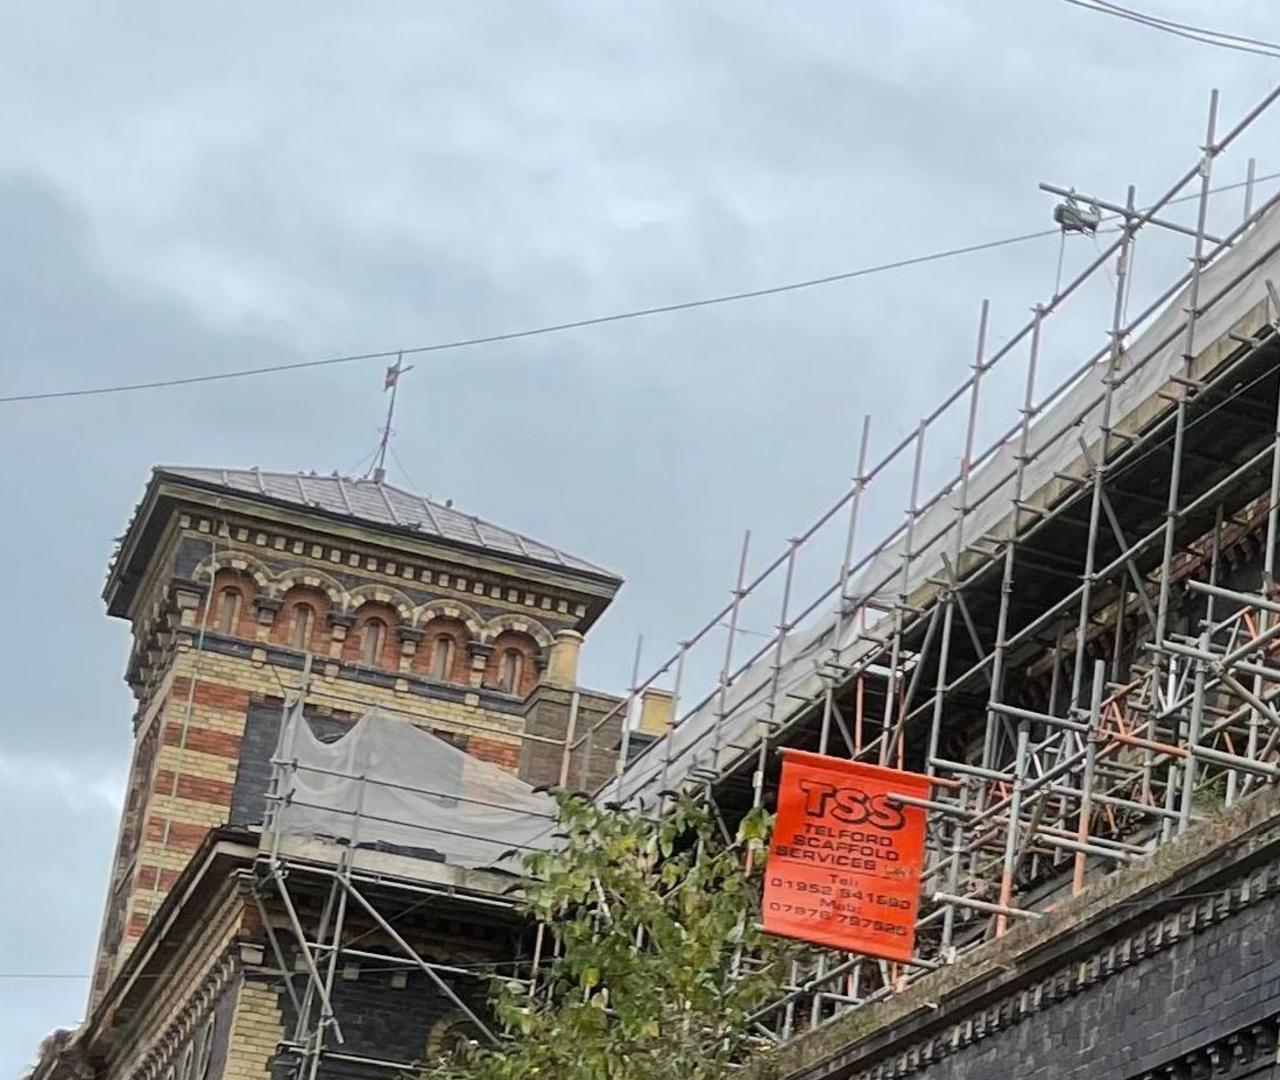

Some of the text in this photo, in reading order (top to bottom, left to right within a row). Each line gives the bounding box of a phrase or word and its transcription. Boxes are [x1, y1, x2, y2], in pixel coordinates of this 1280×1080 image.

[800, 779, 906, 831] TSS
[793, 834, 900, 861] SCAFFOLD
[803, 823, 893, 847] TELFORD
[776, 845, 876, 870] SERVICES
[770, 877, 832, 896] 01952
